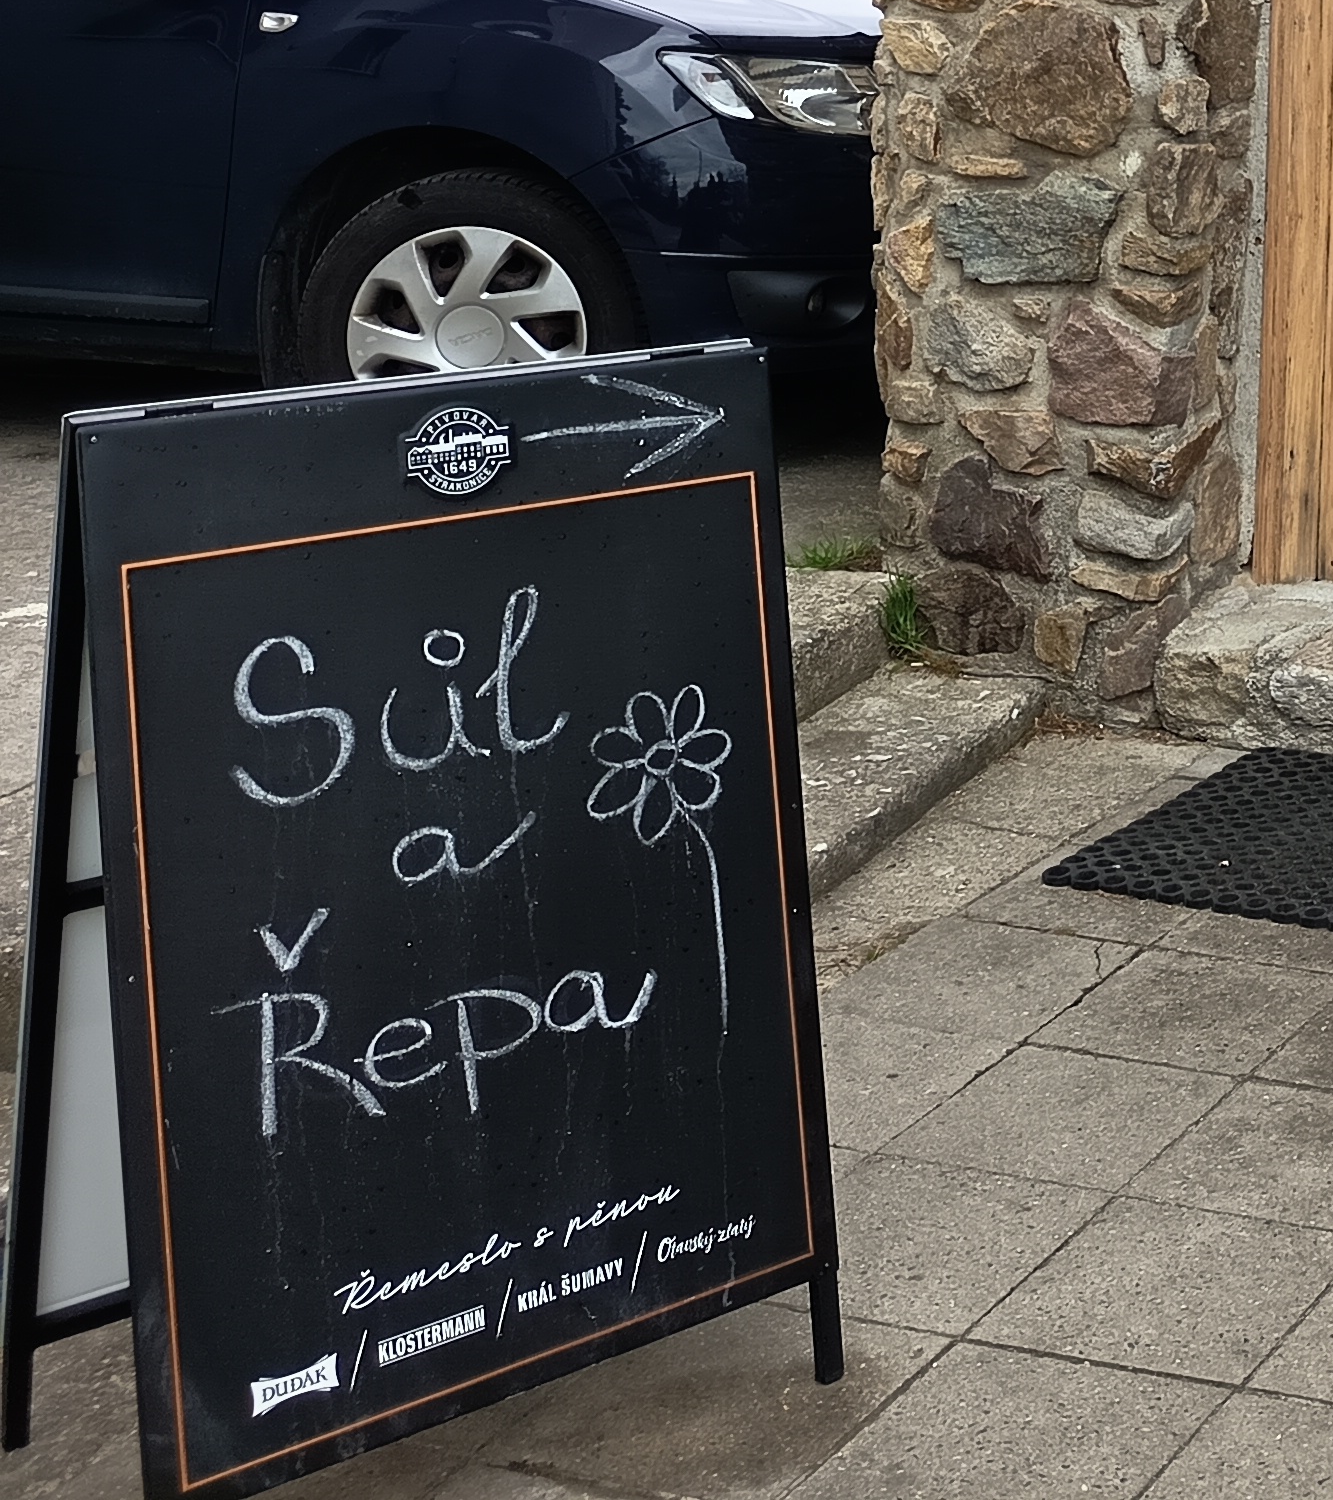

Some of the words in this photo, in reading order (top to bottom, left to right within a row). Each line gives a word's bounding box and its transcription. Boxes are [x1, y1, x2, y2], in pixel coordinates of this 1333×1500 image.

[426, 411, 488, 435] PIVOVAR
[428, 467, 492, 491] STRAKONICE
[443, 459, 477, 475] 1649
[229, 584, 571, 806] Sůl
[391, 810, 538, 885] a
[333, 1233, 522, 1315] Řemeslo
[533, 1225, 554, 1248] s
[563, 1184, 681, 1248] pěnou
[378, 1307, 486, 1365] KLOSTERMANN
[517, 1280, 557, 1313] KRÁL
[561, 1257, 624, 1297] ŠUMAVY
